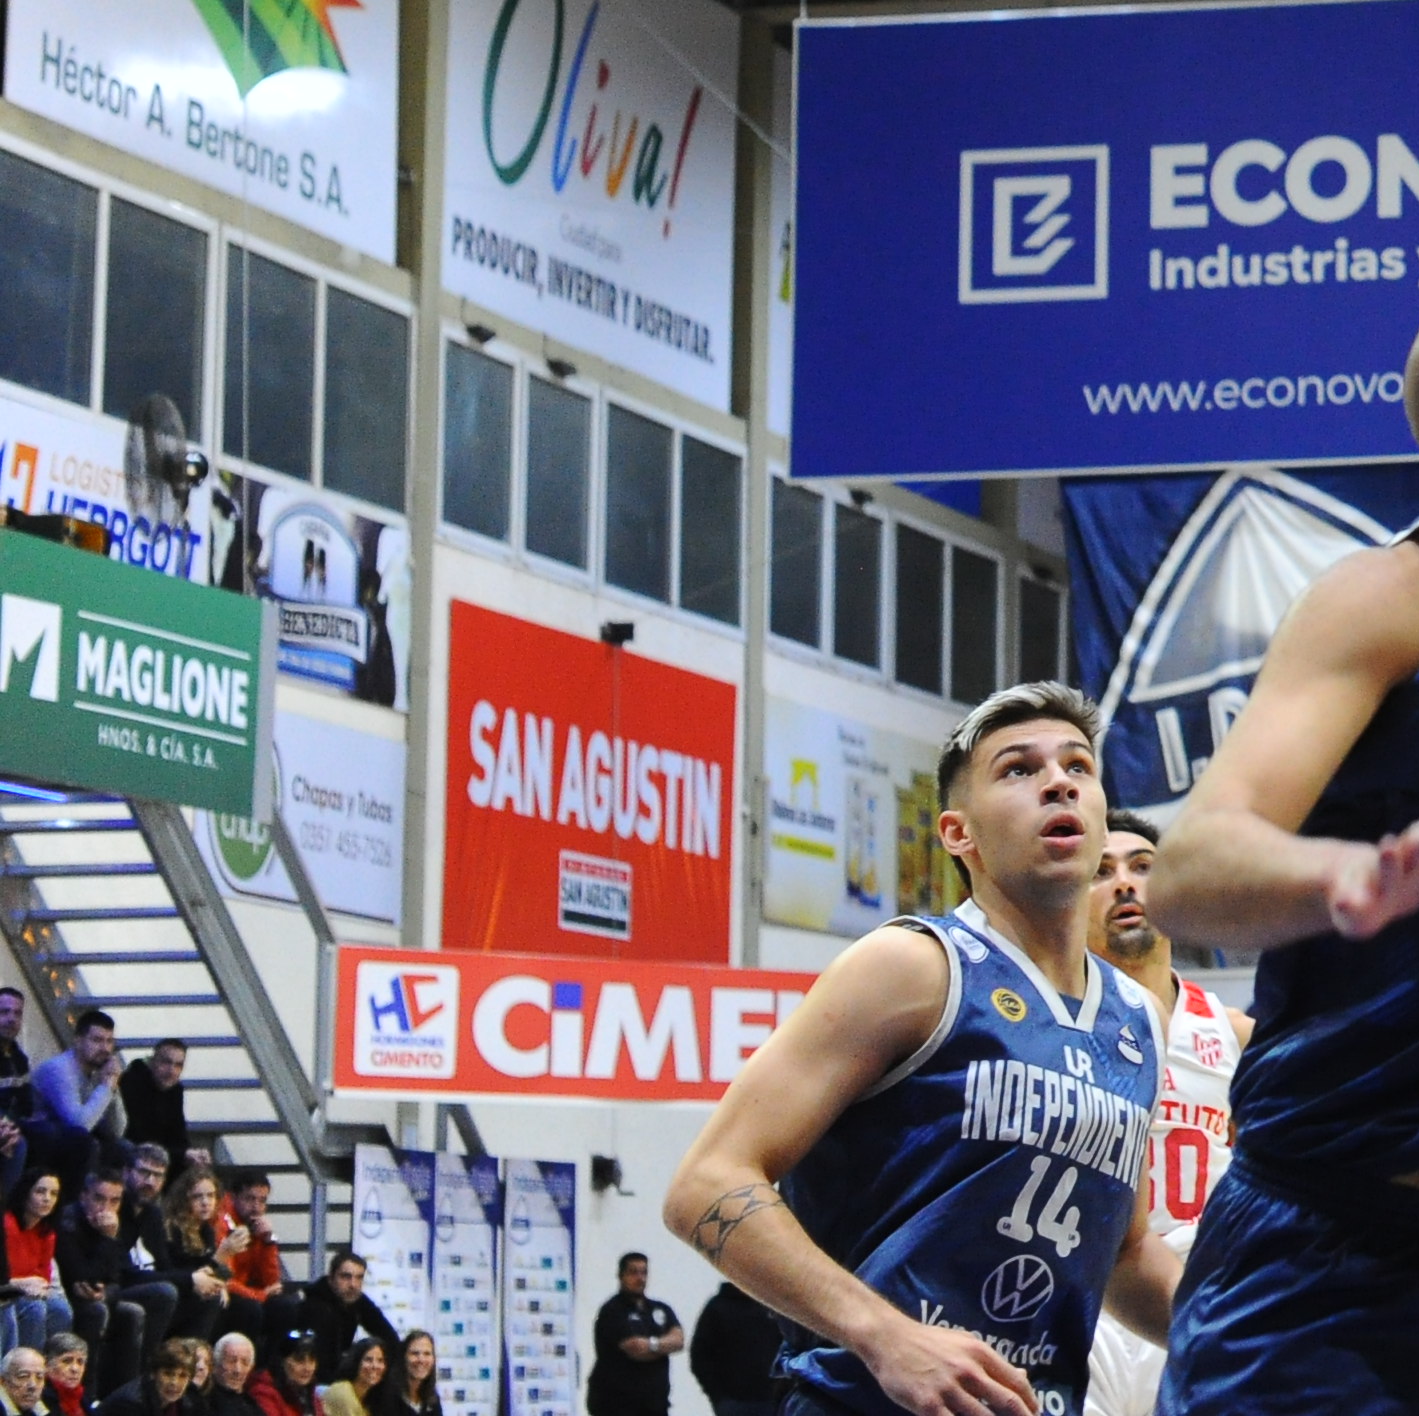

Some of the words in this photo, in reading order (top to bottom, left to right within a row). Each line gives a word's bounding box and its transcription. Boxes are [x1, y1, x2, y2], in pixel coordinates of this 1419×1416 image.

[41, 32, 136, 119] Héctor
[146, 84, 172, 136] A.
[185, 100, 289, 189] Bertone
[299, 152, 349, 216] S.A.
[452, 216, 543, 298] PRODUCIR,
[548, 254, 617, 323] INVERTIR
[620, 288, 630, 326] Y
[1150, 234, 1405, 290] Industrias
[77, 631, 248, 730] MAGLIONE
[98, 724, 142, 754] HNOS.
[146, 734, 157, 757] &
[193, 745, 218, 770] S.A.
[467, 699, 555, 822] SAN
[556, 723, 722, 860] AGUSTIN
[370, 1050, 444, 1070] CIMENTO
[472, 974, 800, 1082] CiME
[996, 1155, 1081, 1258] 14
[1150, 1128, 1210, 1222] 0
